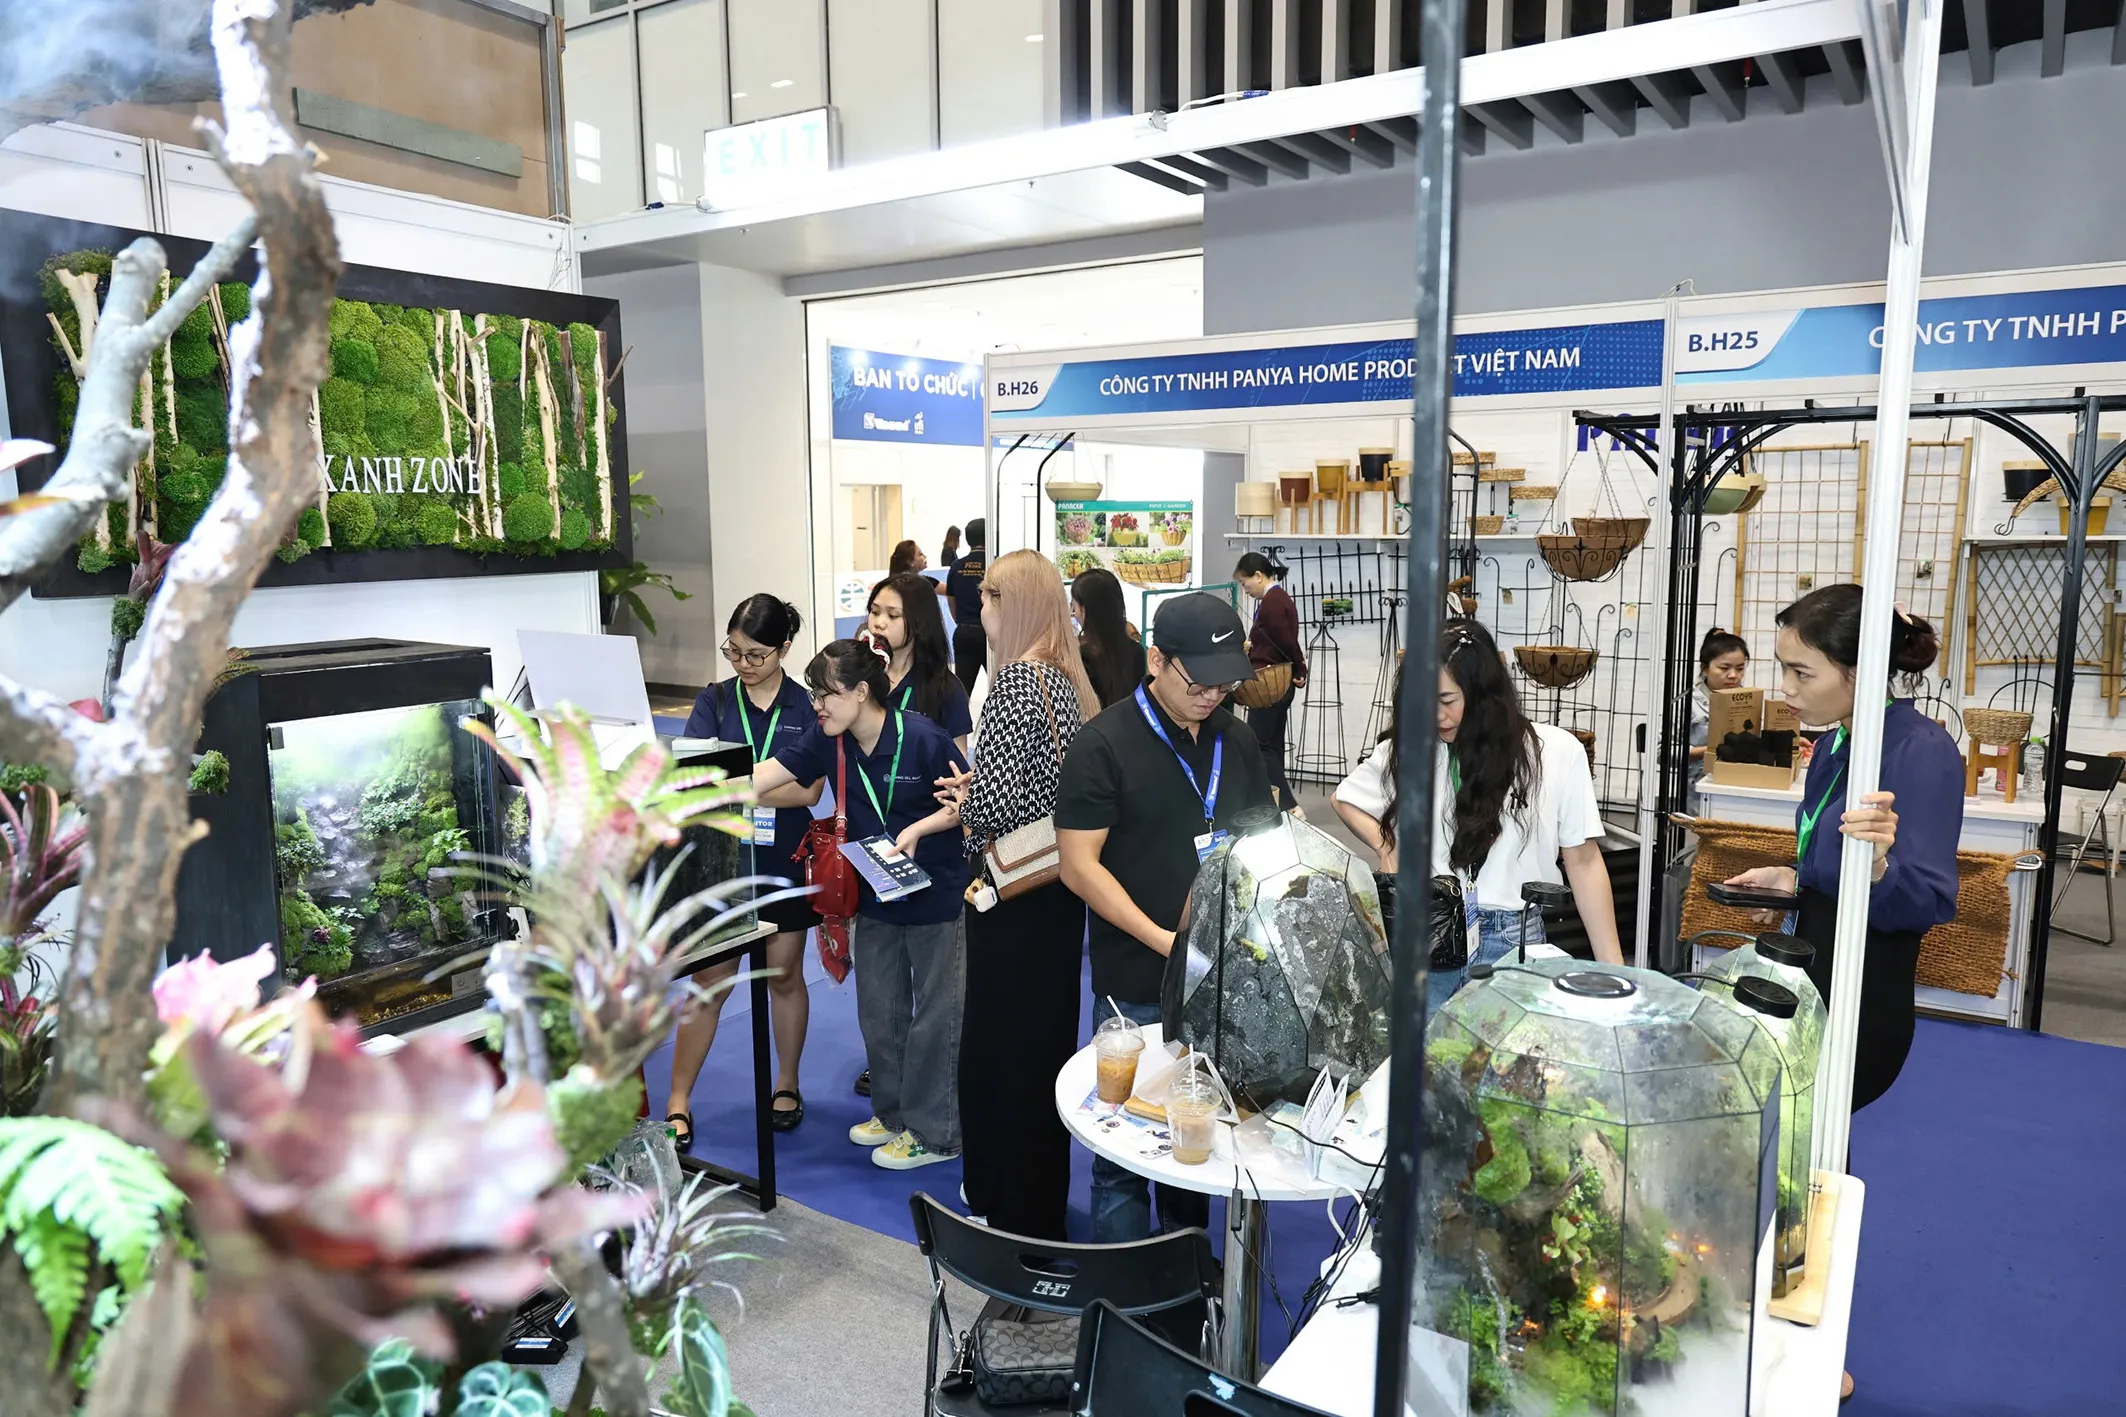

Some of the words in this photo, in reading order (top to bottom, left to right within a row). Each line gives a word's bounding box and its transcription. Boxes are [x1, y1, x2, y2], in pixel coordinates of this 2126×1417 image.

[718, 122, 820, 175] EXIT
[1688, 331, 1759, 352] B.H25
[1868, 321, 1955, 348] CNG
[1962, 318, 2003, 343] TY
[2007, 311, 2101, 340] TNHH
[853, 367, 892, 389] BAN
[997, 381, 1039, 397] B.H26
[1100, 374, 1149, 396] CÔNG
[1152, 373, 1175, 394] TY
[1177, 370, 1228, 392] TNHH
[1232, 366, 1294, 388] PANYA
[1299, 362, 1359, 384] HOME
[1471, 348, 1520, 377] VIỆT
[1525, 346, 1580, 370] NAM
[316, 454, 405, 494] XANH
[410, 456, 481, 494] ZONE
